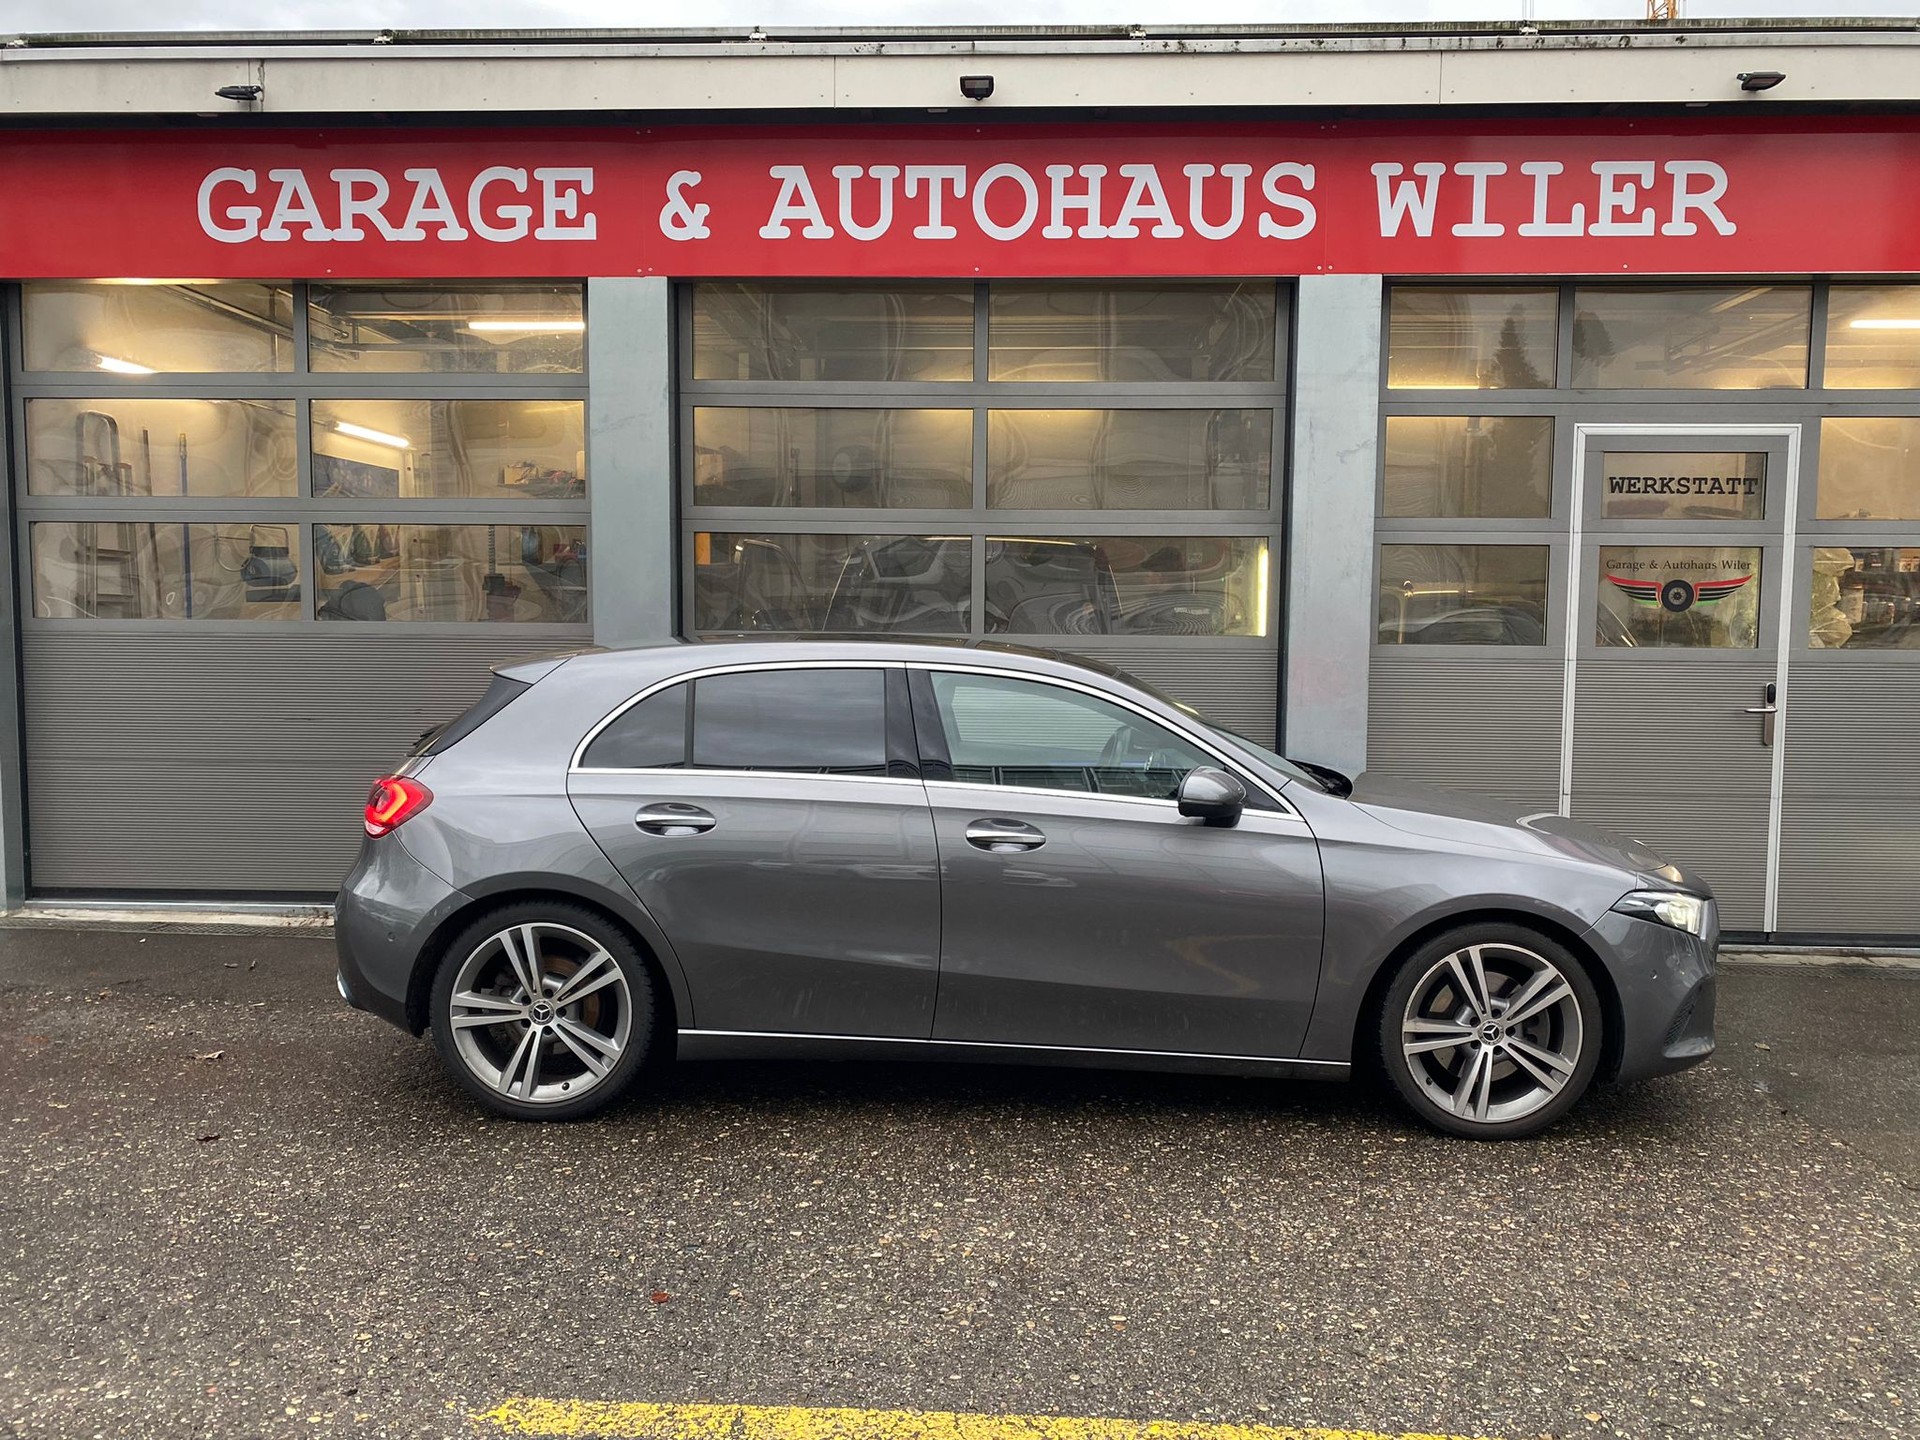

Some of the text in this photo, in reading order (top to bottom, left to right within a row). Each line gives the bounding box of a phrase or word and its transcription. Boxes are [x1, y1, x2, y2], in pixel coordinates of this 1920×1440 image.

[197, 160, 1737, 243] GARAGE & AUTOHAUS WILER
[1609, 476, 1759, 495] WERKSTATT
[1606, 559, 1752, 572] Garage & Autohaus Wiler
